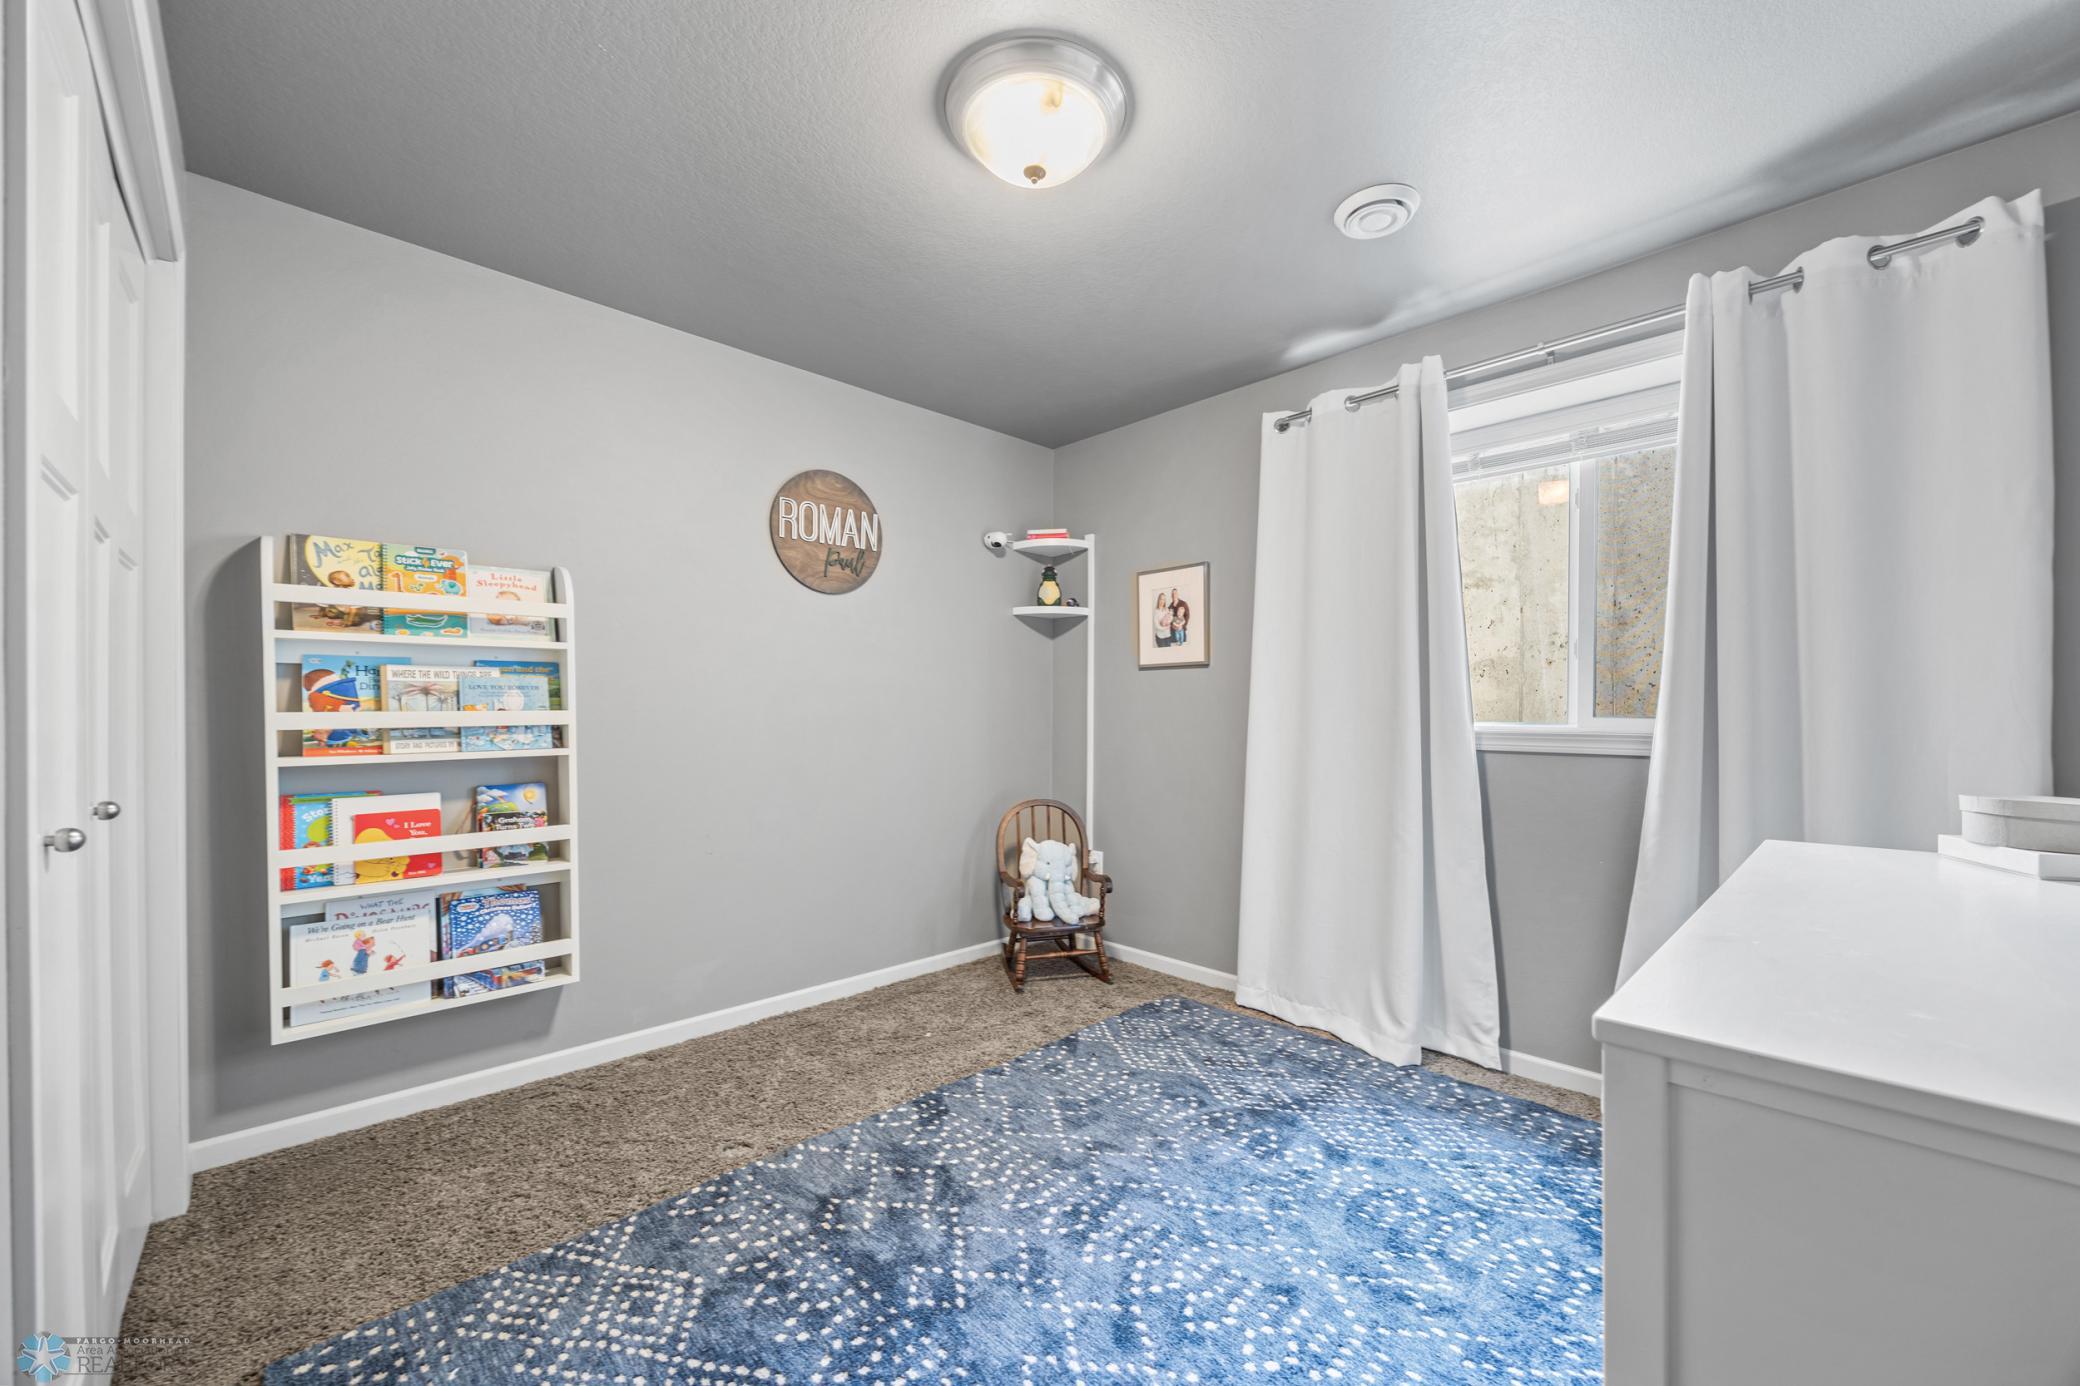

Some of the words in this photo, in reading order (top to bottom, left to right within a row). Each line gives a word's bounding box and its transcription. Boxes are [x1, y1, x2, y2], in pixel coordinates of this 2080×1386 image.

[778, 496, 879, 552] ROMAN
[313, 541, 353, 568] Max
[396, 555, 421, 566] Stick
[430, 559, 454, 568] Ever
[490, 573, 522, 582] Little
[477, 580, 537, 591] Sleepyhead
[391, 669, 417, 678] WHERE
[418, 670, 432, 678] THE
[434, 671, 451, 679] WILD
[360, 901, 384, 910] WHAT
[386, 898, 404, 907] THE
[306, 925, 329, 934] We're
[331, 921, 356, 932] Going
[375, 915, 396, 925] Bear
[396, 914, 416, 922] Hunt
